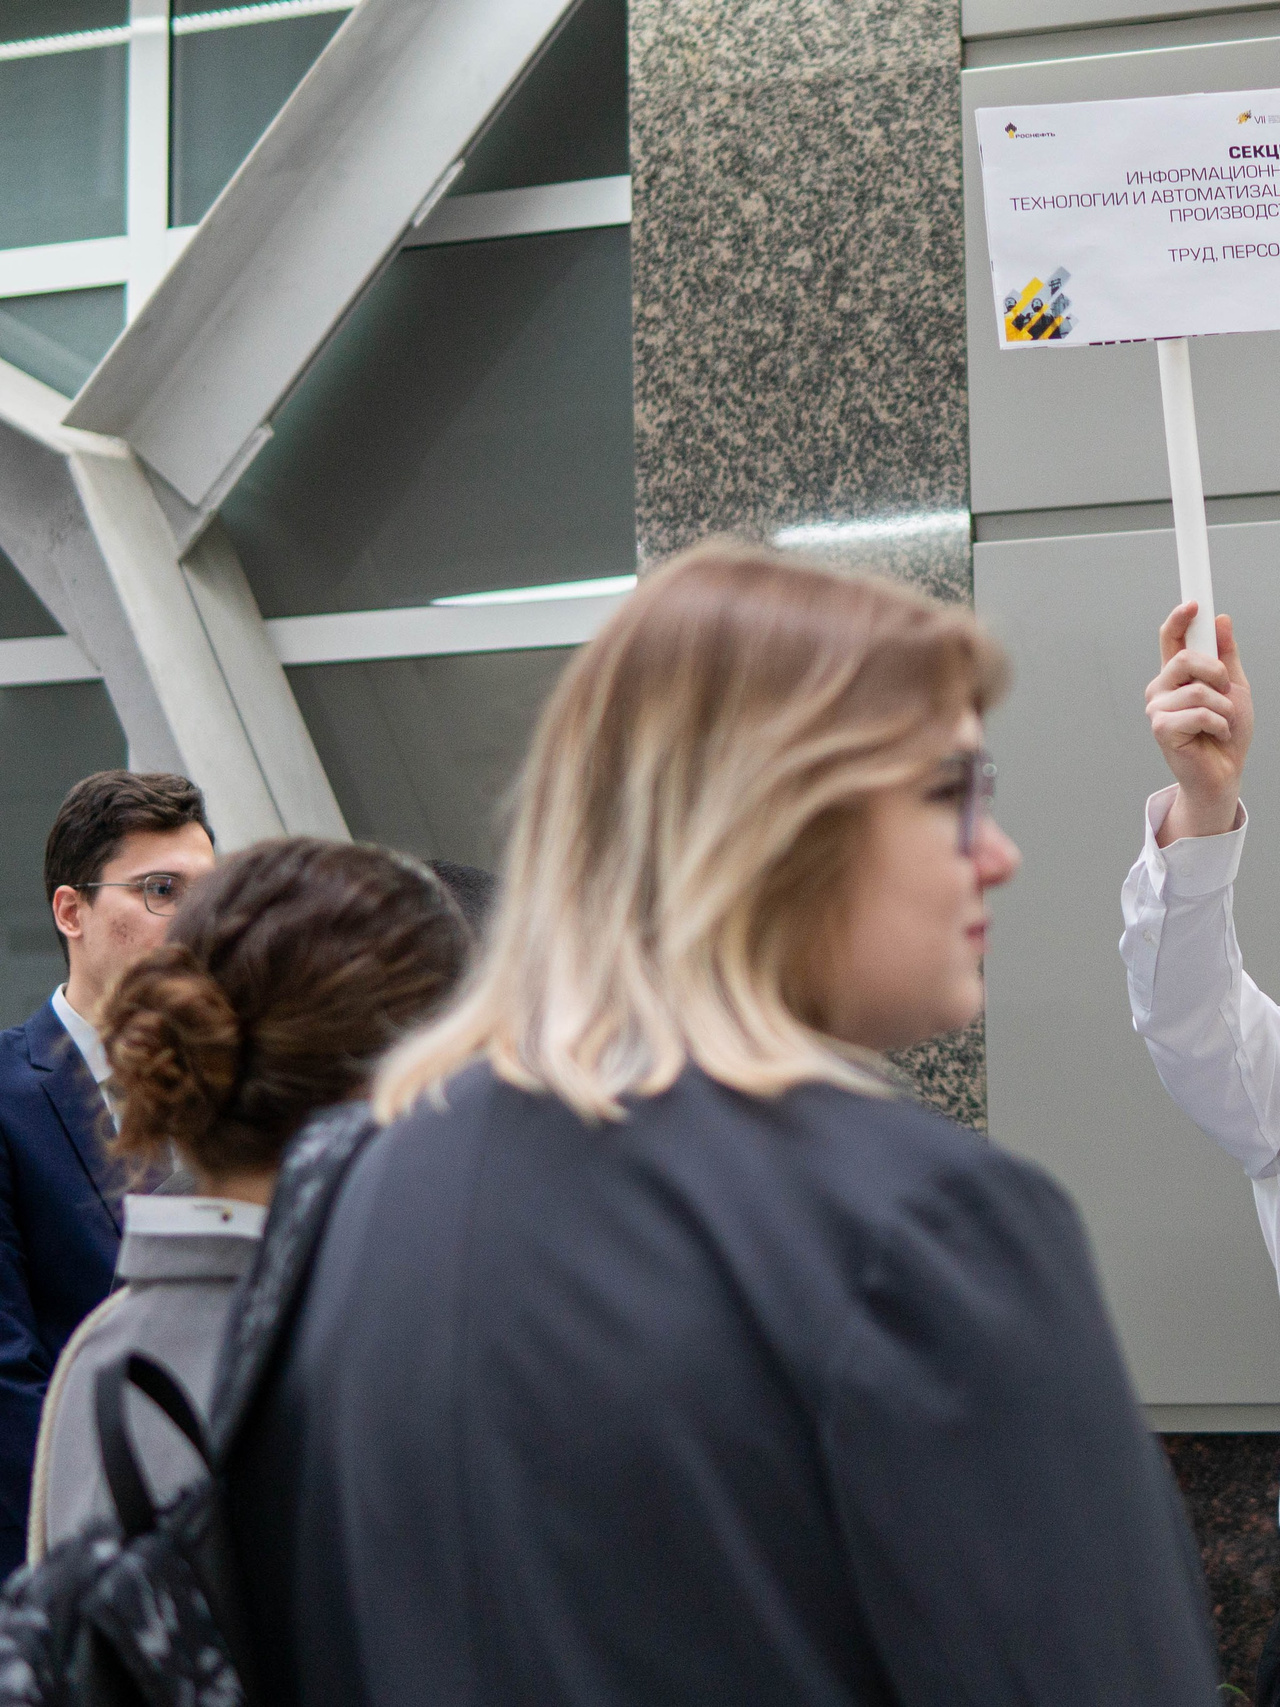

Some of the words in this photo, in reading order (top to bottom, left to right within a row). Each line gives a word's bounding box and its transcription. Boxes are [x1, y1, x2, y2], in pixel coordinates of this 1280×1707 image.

[1010, 191, 1128, 211] ТЕХНОЛОГИИ
[1133, 190, 1147, 205] И
[1168, 247, 1219, 263] ТРУД,
